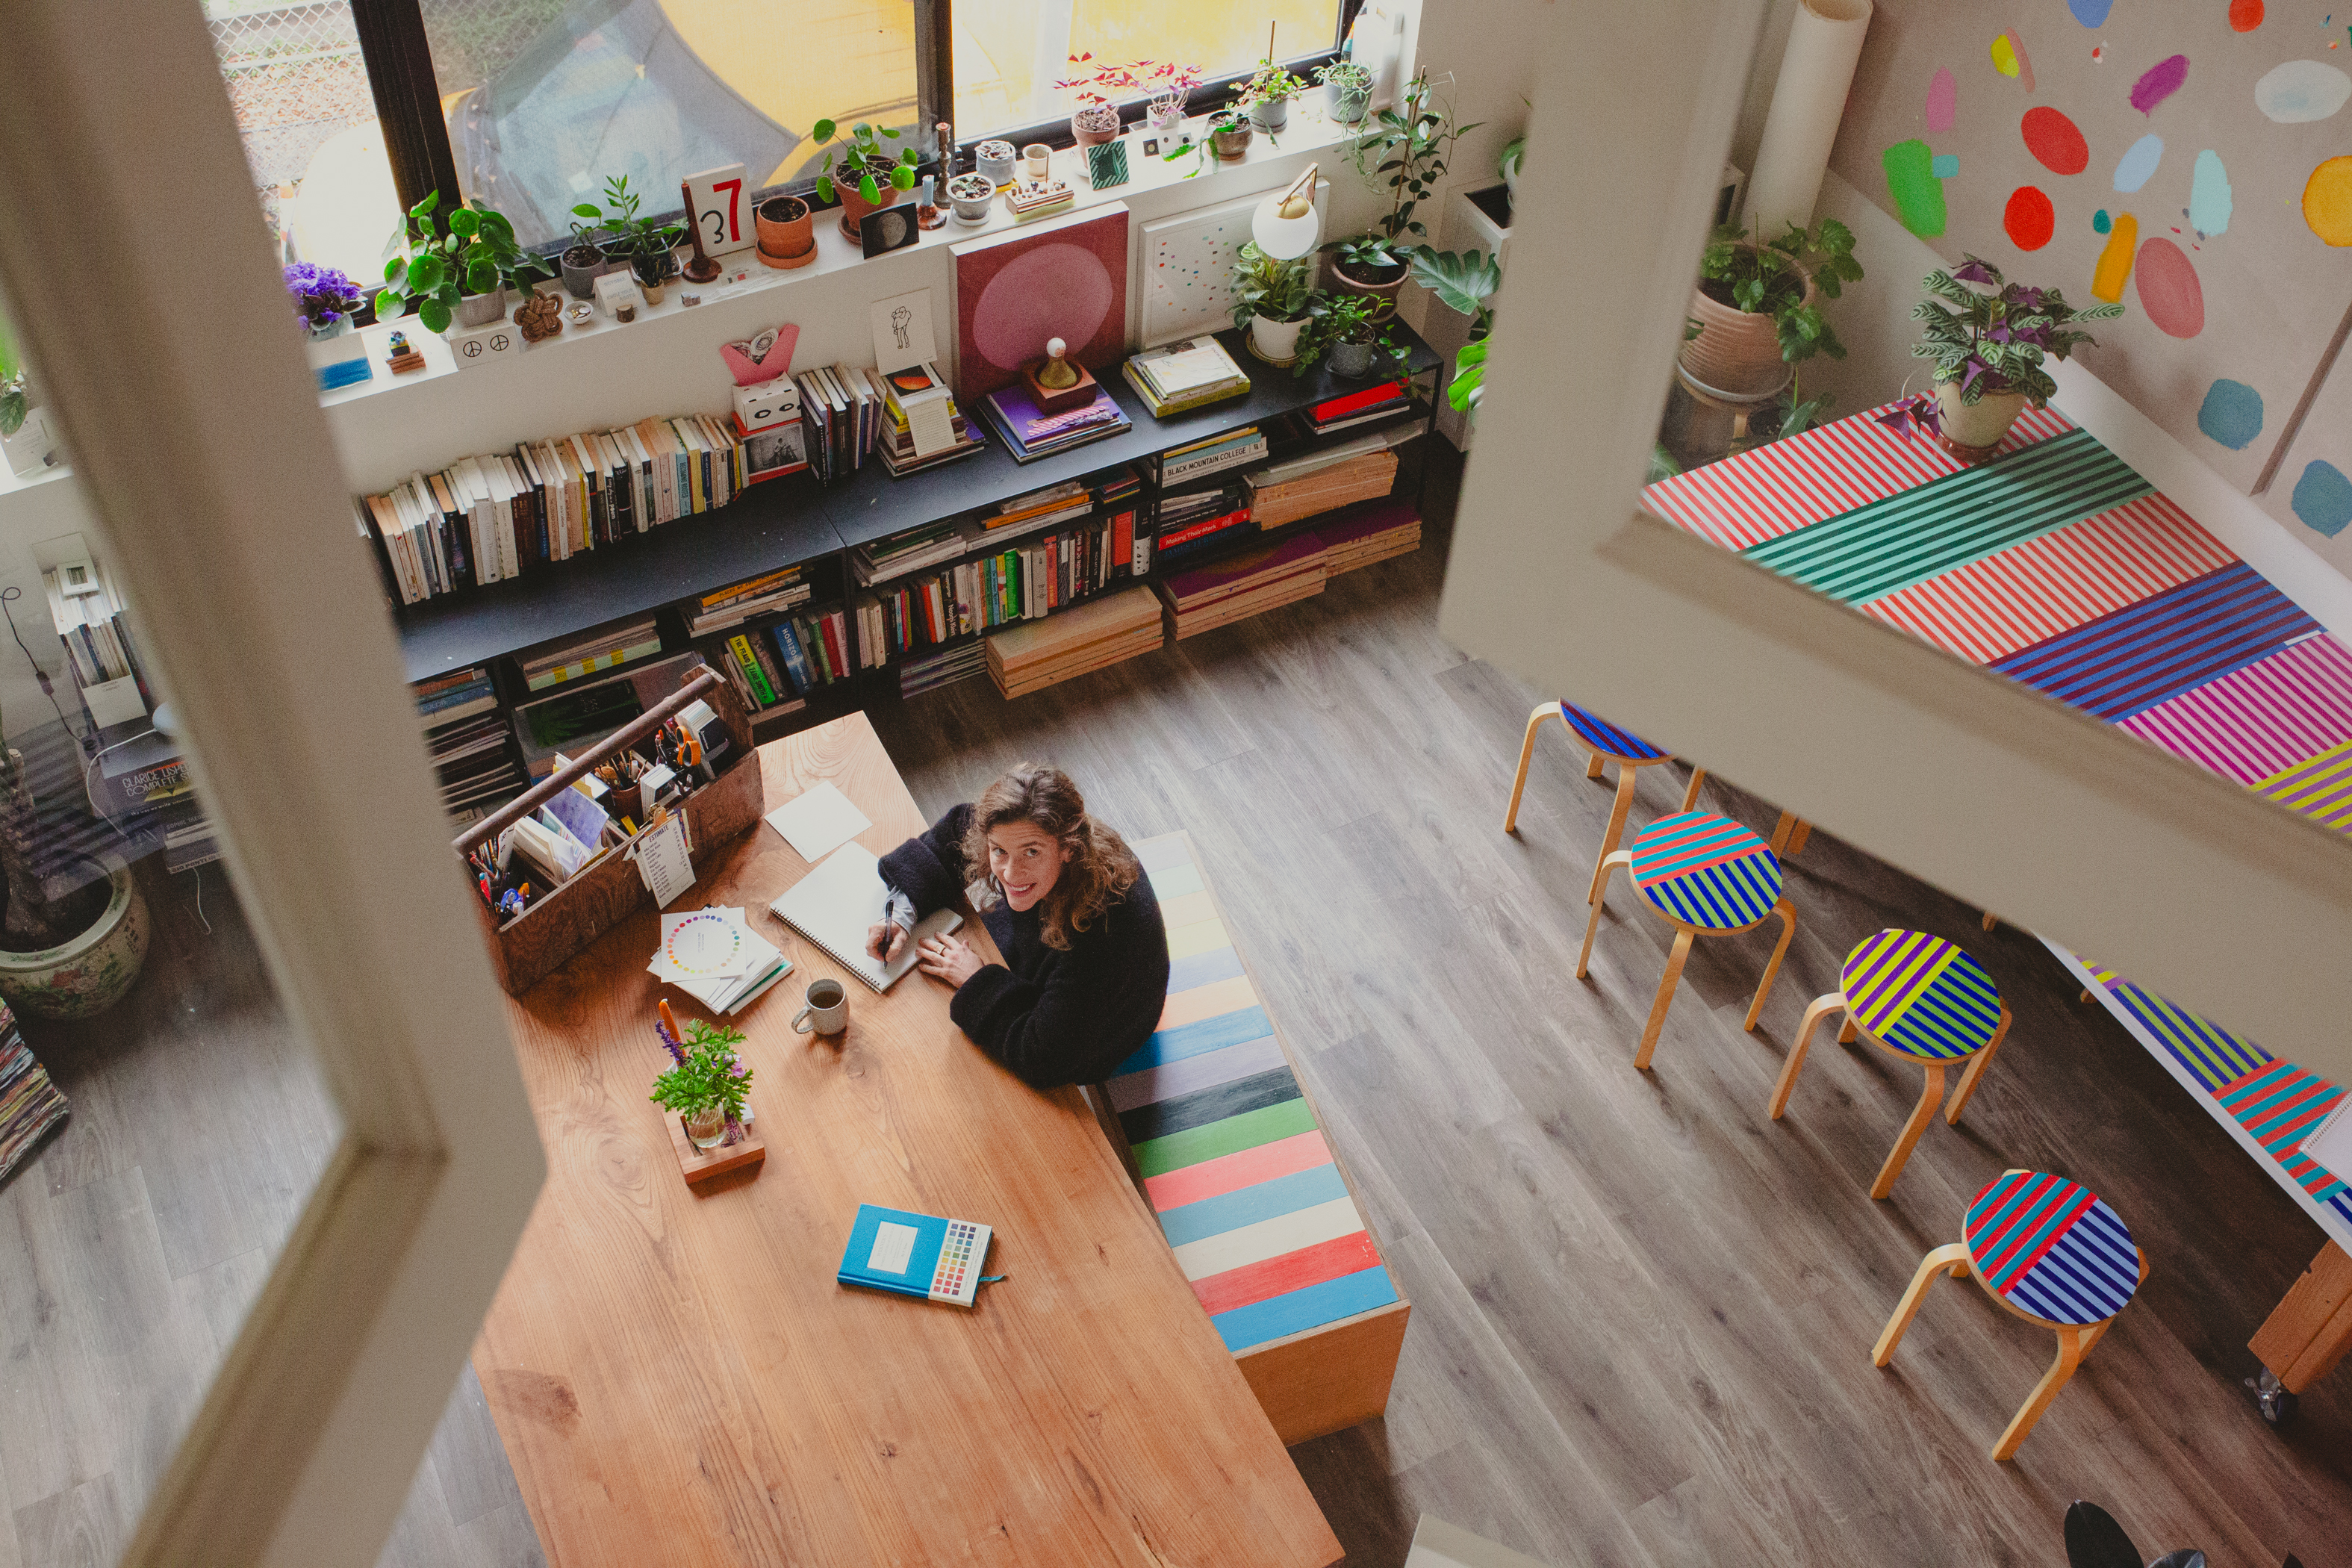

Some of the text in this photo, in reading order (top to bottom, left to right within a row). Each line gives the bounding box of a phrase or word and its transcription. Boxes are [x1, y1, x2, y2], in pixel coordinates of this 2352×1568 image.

[1166, 464, 1187, 476] BLACK
[1187, 455, 1219, 470] MOUNTAIN
[1219, 447, 1247, 460] COLLEGE
[1165, 523, 1216, 545] Making Their Mark
[718, 587, 735, 597] PLACES
[782, 628, 798, 661] HORIZON
[734, 638, 743, 648] THE
[739, 647, 750, 663] FRAUD
[748, 666, 759, 680] ZADIE
[755, 679, 767, 696] SMITH
[122, 770, 159, 788] CLARICE
[125, 774, 178, 797] COMPLETE
[648, 824, 669, 842] ESTIMATE
[185, 858, 207, 868] PONTI
